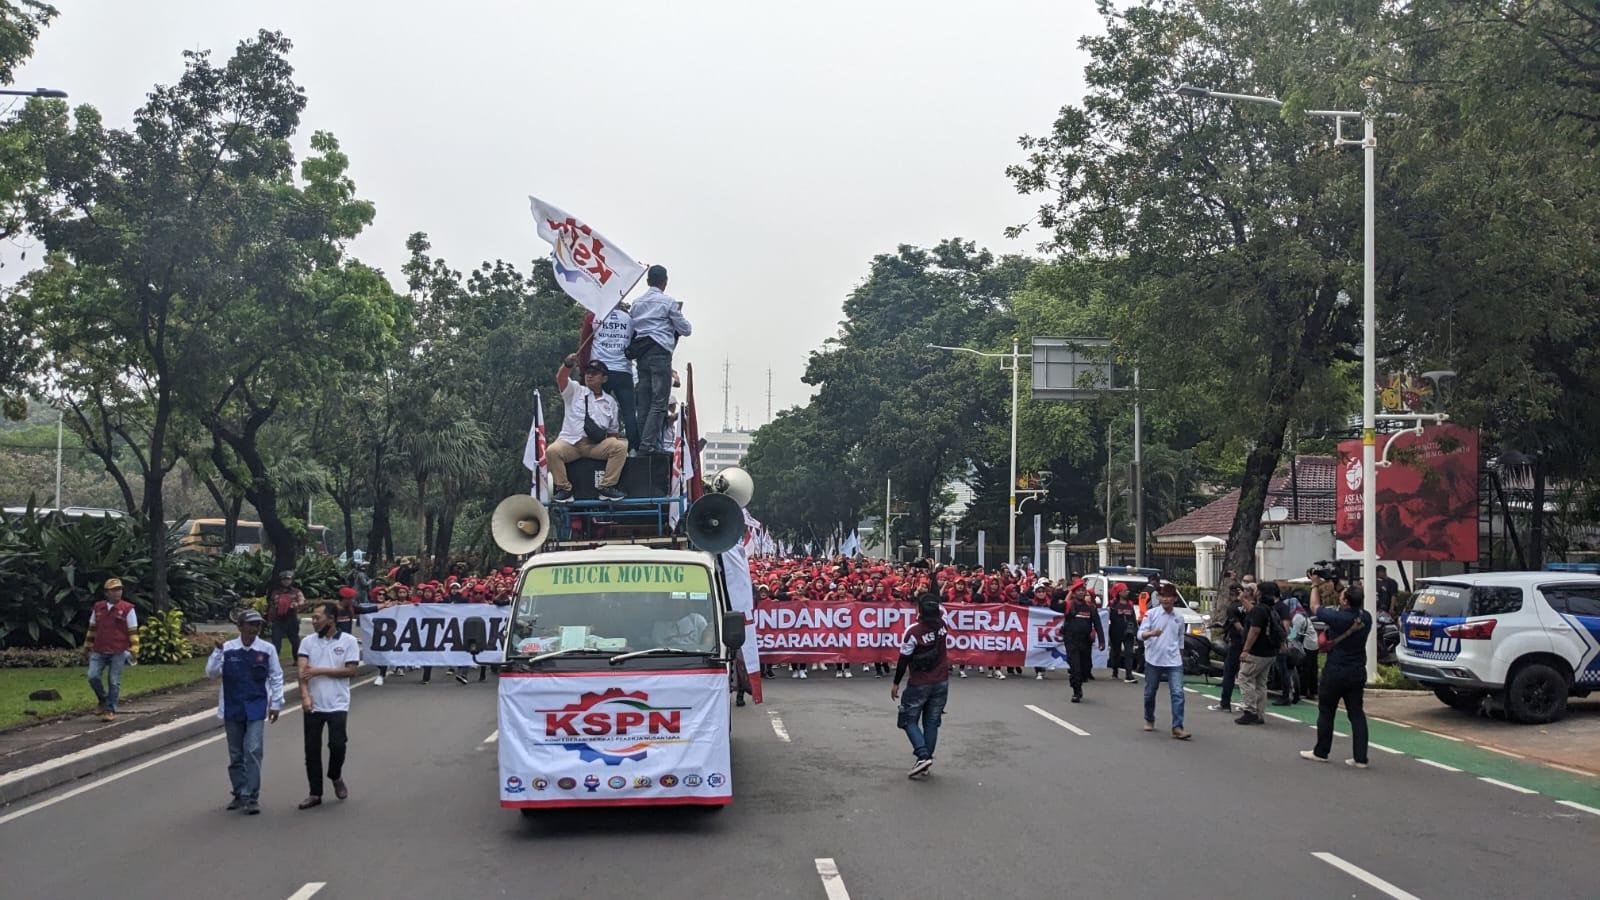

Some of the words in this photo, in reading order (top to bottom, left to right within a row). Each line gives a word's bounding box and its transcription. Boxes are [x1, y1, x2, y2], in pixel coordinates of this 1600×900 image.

[602, 322, 627, 330] KSPN
[552, 566, 610, 584] TRUCK
[617, 566, 685, 583] MOVING
[755, 608, 852, 629] NDANG
[858, 608, 916, 629] CIPT
[1406, 616, 1433, 626] POLISI
[371, 617, 507, 652] BATAK
[756, 632, 851, 648] GSARAKAN
[857, 632, 905, 649] BURU
[946, 634, 1025, 651] DONESIA
[1037, 627, 1064, 644] KS
[546, 711, 681, 737] KSPN
